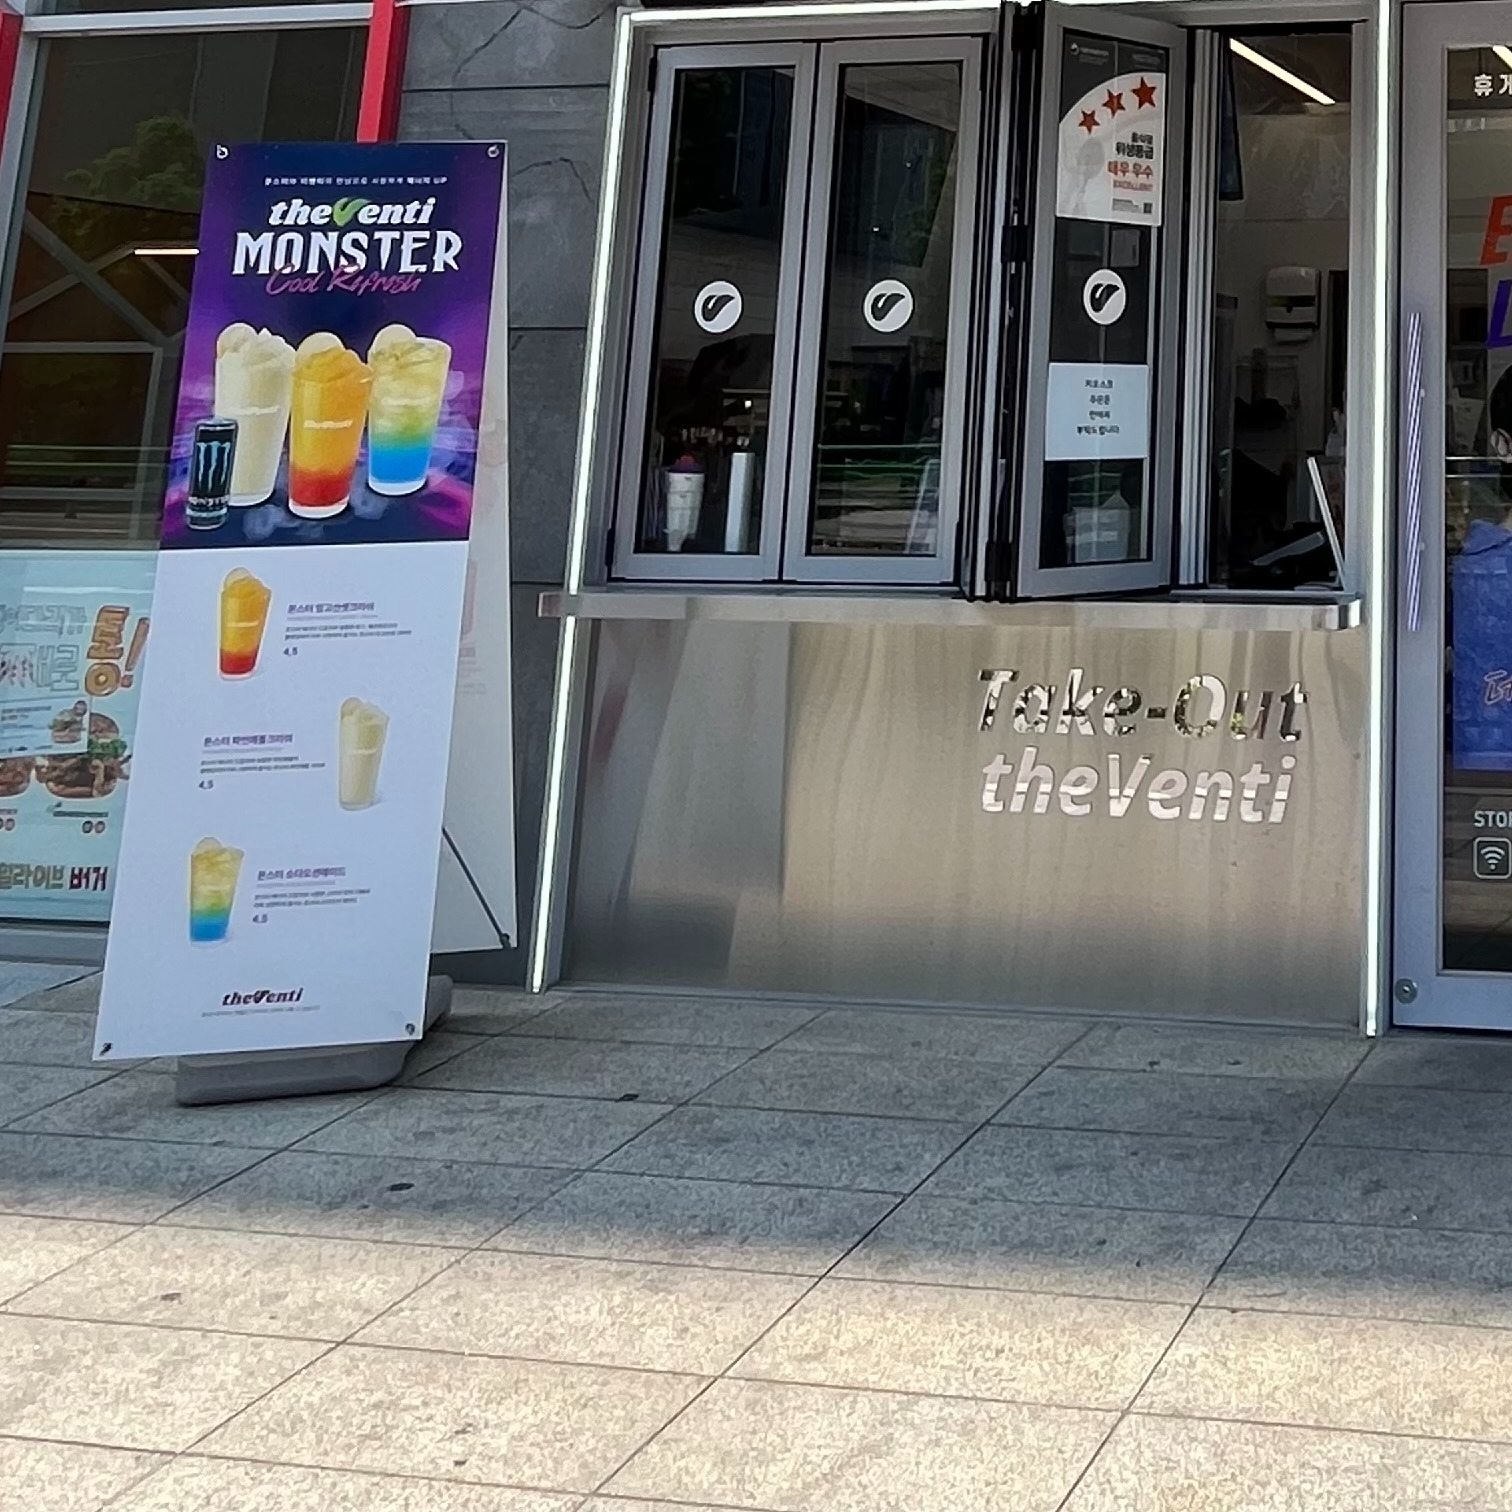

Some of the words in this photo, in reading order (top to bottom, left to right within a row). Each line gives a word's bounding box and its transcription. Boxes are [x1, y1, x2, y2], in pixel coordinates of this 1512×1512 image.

[268, 196, 437, 228] theVenti
[232, 230, 463, 276] MONSTER
[265, 263, 319, 296] Cool
[326, 265, 423, 296] Refresh
[978, 668, 1310, 742] Take-Out
[980, 745, 1298, 824] theVenti
[68, 866, 109, 892] 버거
[220, 988, 304, 1006] theVenti
